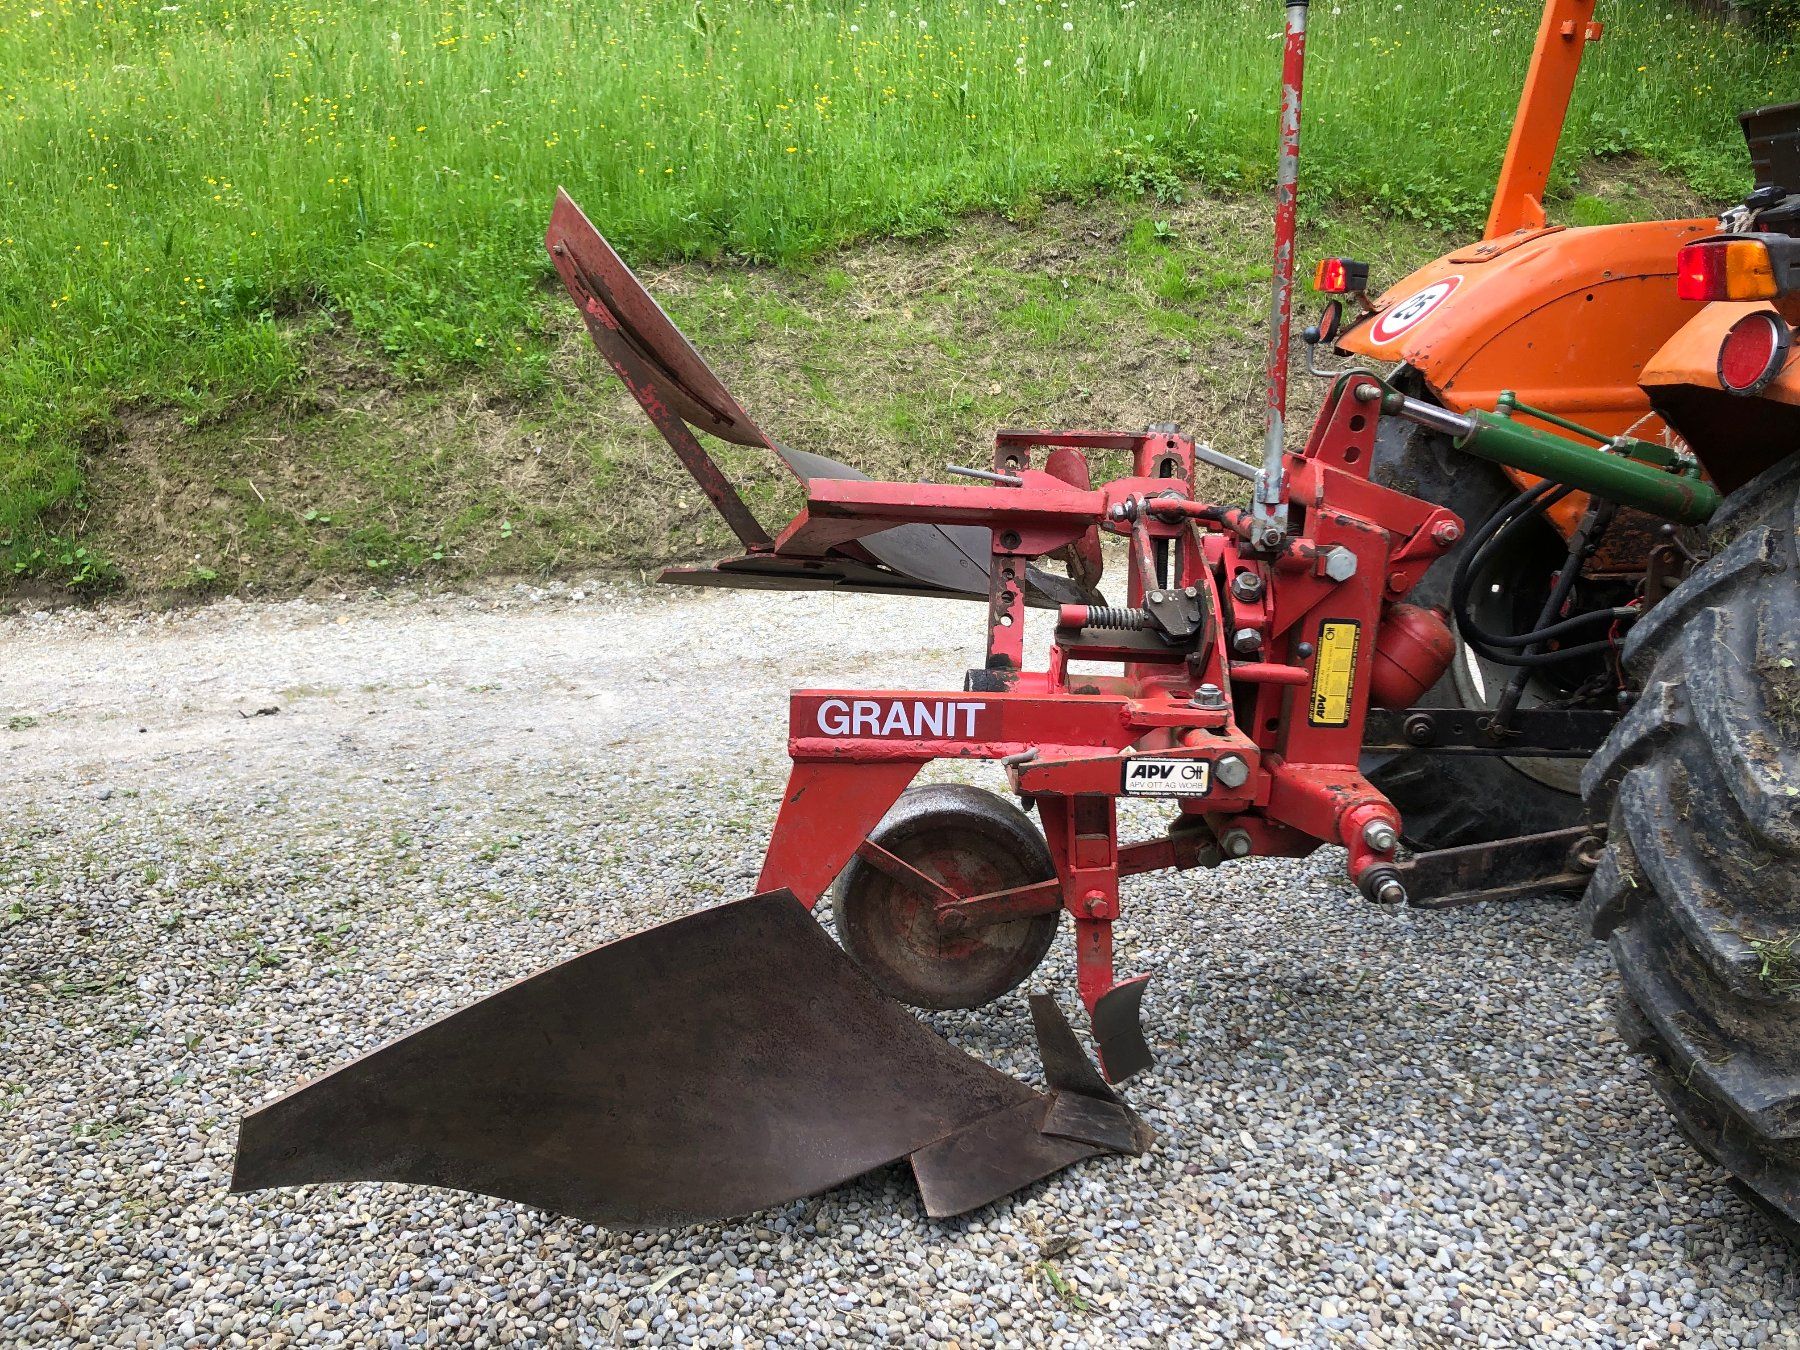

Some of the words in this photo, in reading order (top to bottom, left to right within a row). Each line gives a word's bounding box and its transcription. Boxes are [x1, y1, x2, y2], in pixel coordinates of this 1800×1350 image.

[1392, 294, 1436, 320] 25
[816, 699, 986, 738] GRANIT
[1316, 694, 1327, 719] APV
[1130, 764, 1175, 779] APV
[1165, 781, 1176, 789] AG
[1179, 781, 1203, 789] WORB
